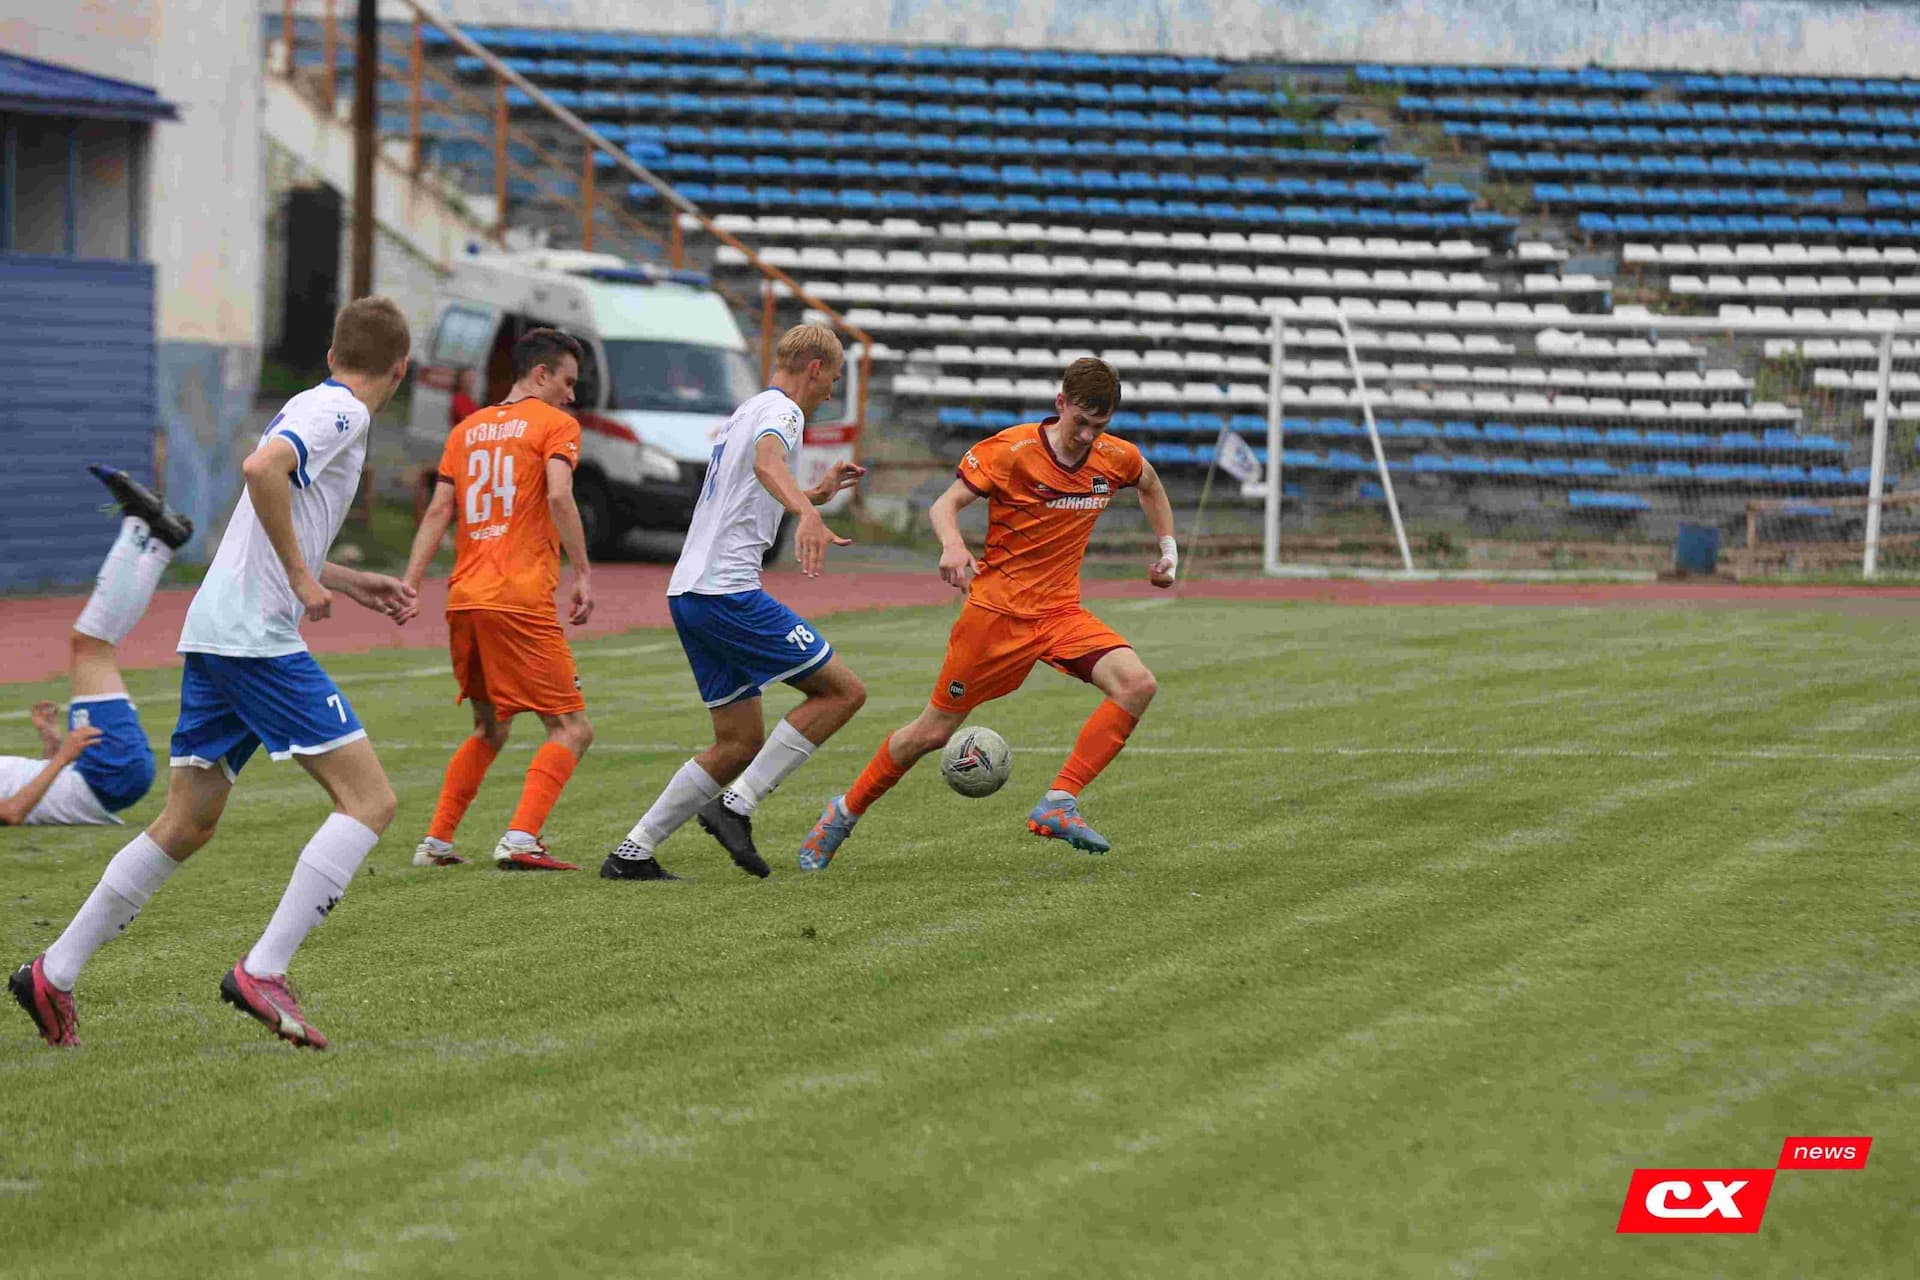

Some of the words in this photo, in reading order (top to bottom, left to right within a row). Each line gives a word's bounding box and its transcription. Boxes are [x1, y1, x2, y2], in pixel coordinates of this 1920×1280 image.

[466, 446, 517, 524] 24
[785, 624, 815, 652] 78
[326, 693, 347, 724] 7
